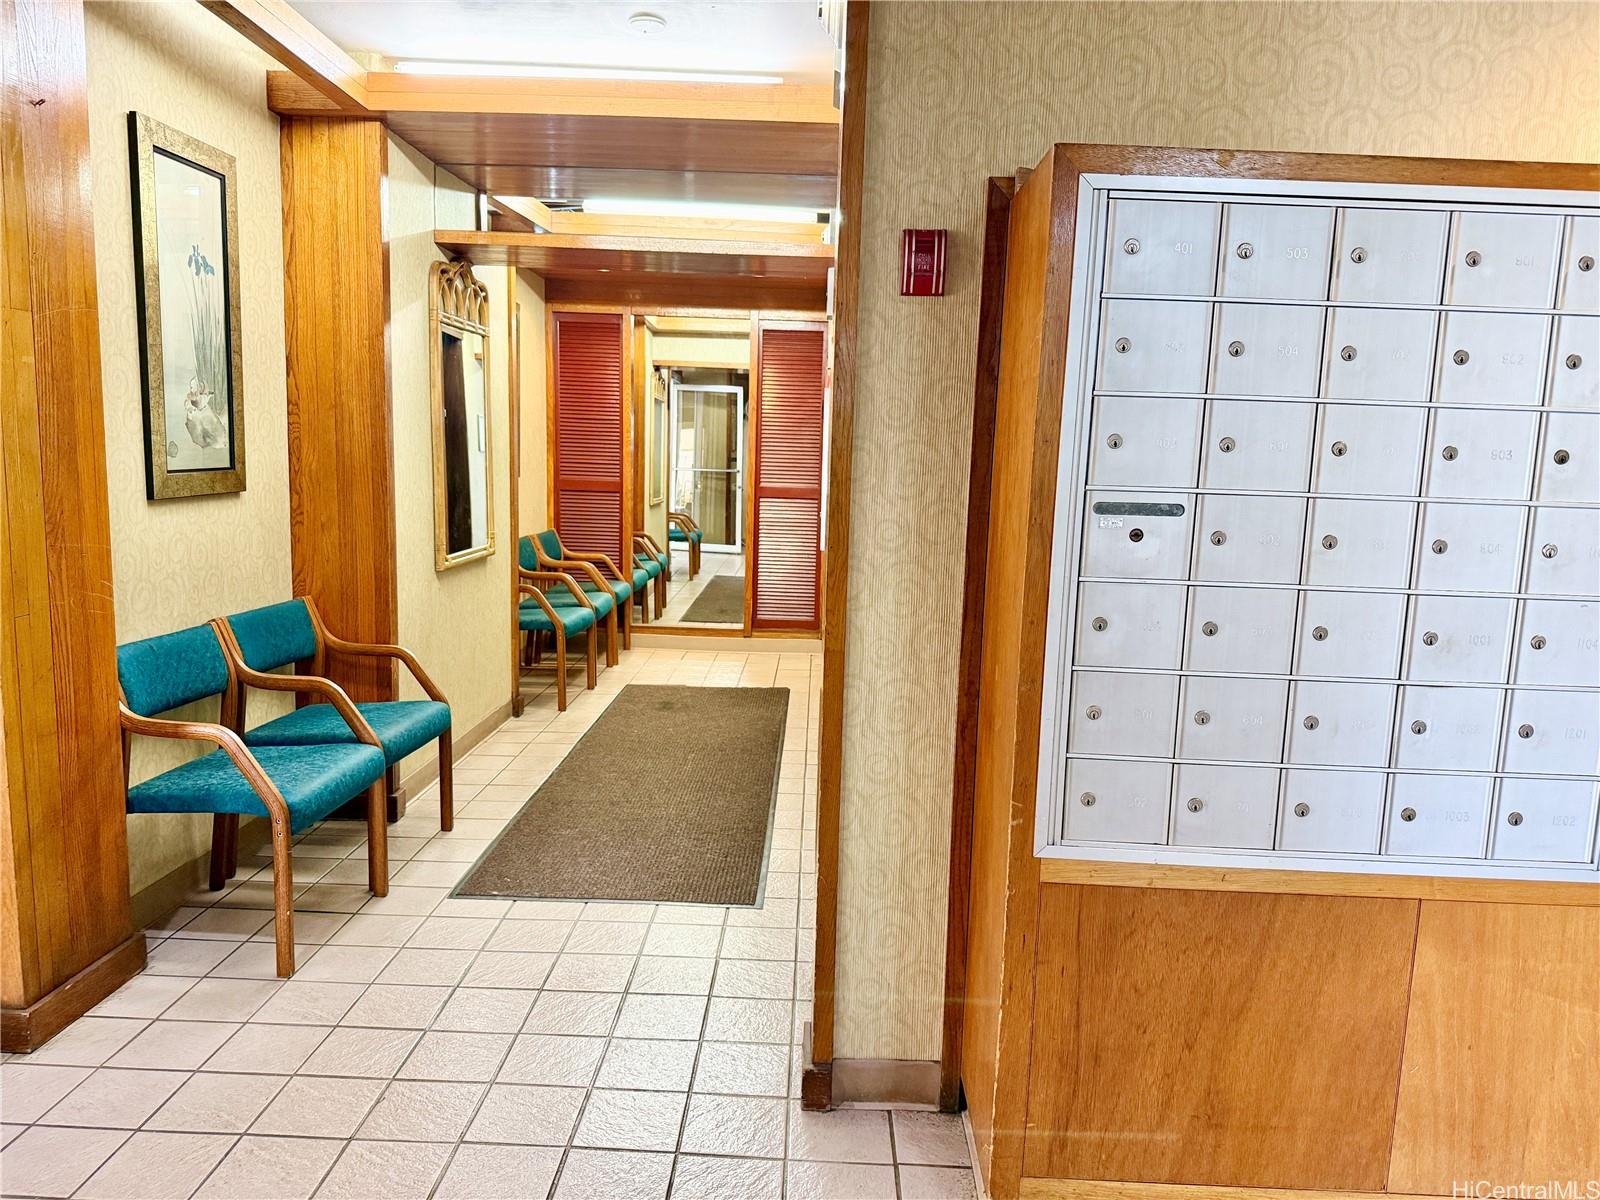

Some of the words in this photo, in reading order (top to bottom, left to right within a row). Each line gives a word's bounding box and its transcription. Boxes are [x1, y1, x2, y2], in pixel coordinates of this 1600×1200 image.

[1175, 242, 1192, 255] 401
[1287, 247, 1309, 259] 503
[1468, 634, 1491, 647] 1001
[1551, 815, 1576, 827] 1202
